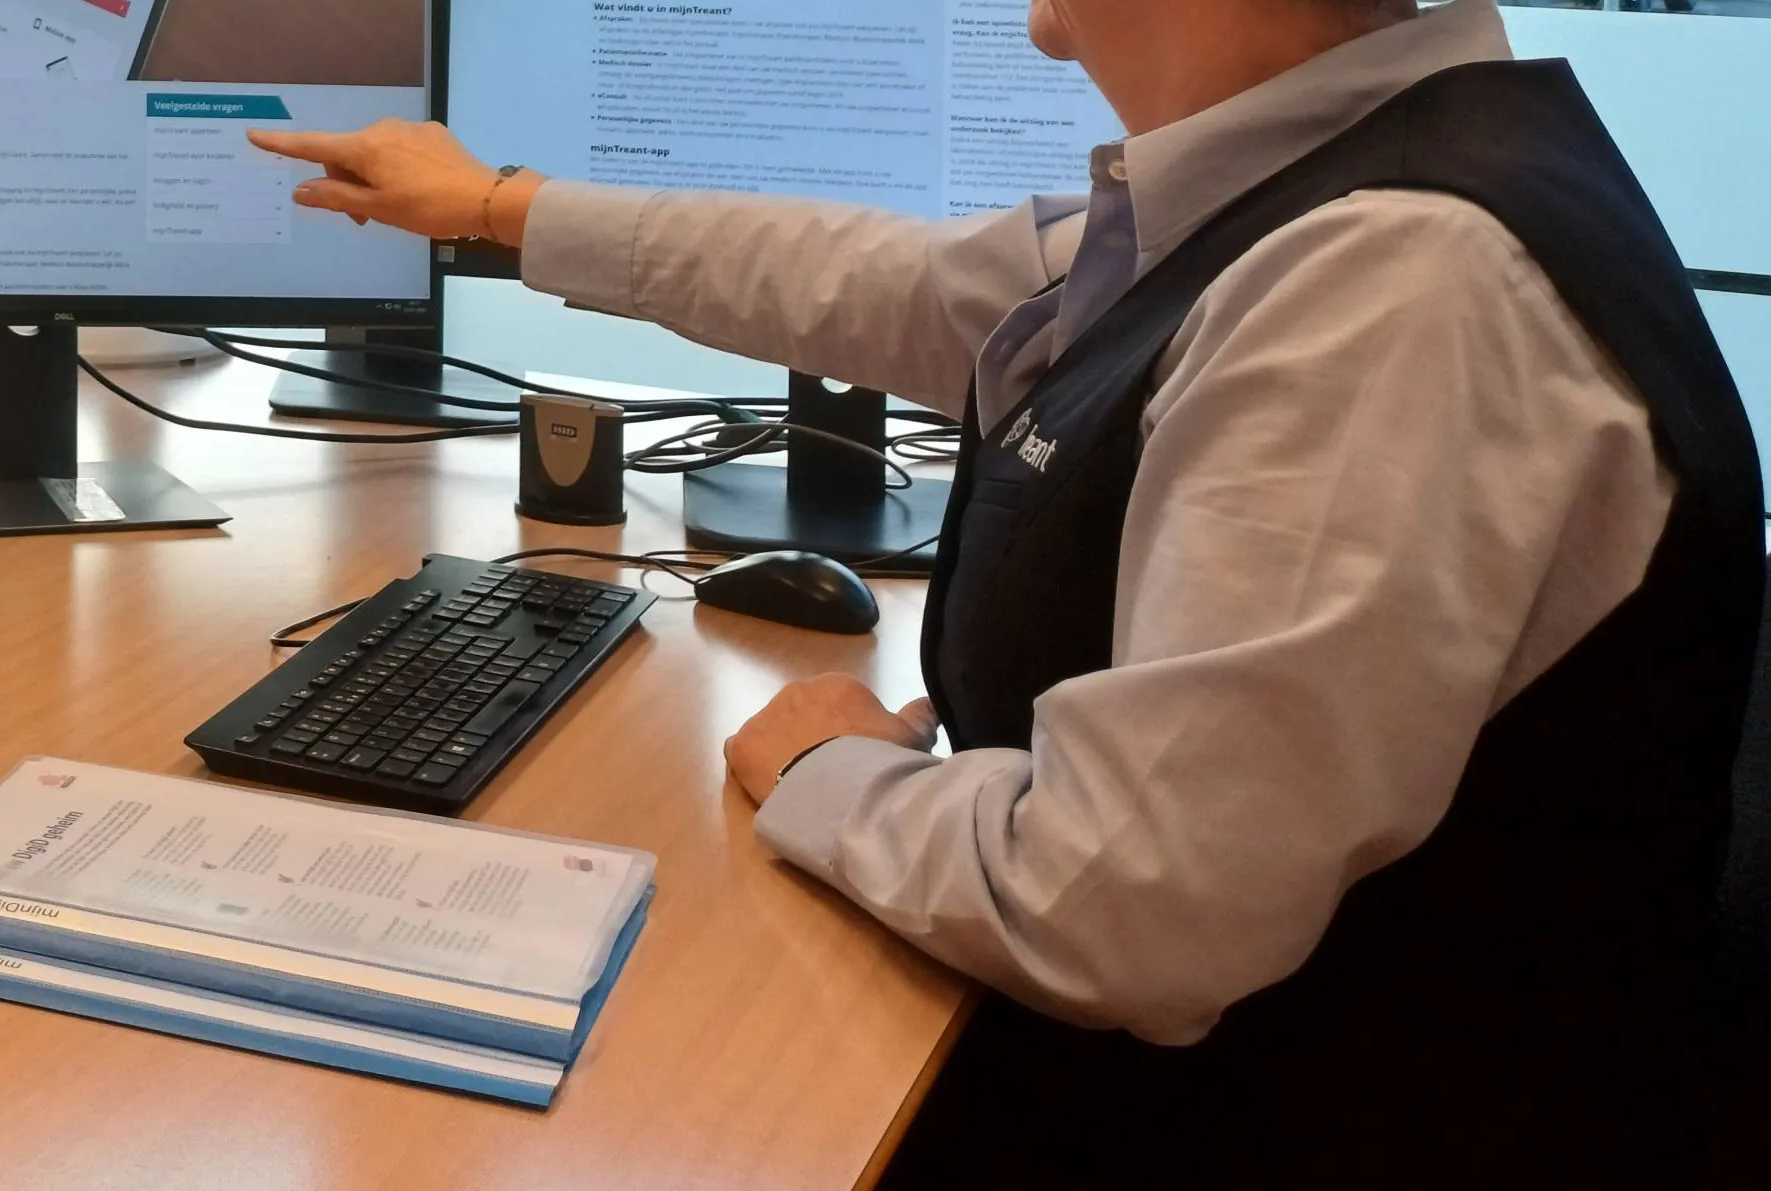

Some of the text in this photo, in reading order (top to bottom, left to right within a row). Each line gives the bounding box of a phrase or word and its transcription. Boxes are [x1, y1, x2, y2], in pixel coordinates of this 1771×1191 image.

[153, 100, 244, 113] Veelgestelde vragen
[590, 143, 671, 158] mijnTreant-app
[54, 312, 76, 321] DELL
